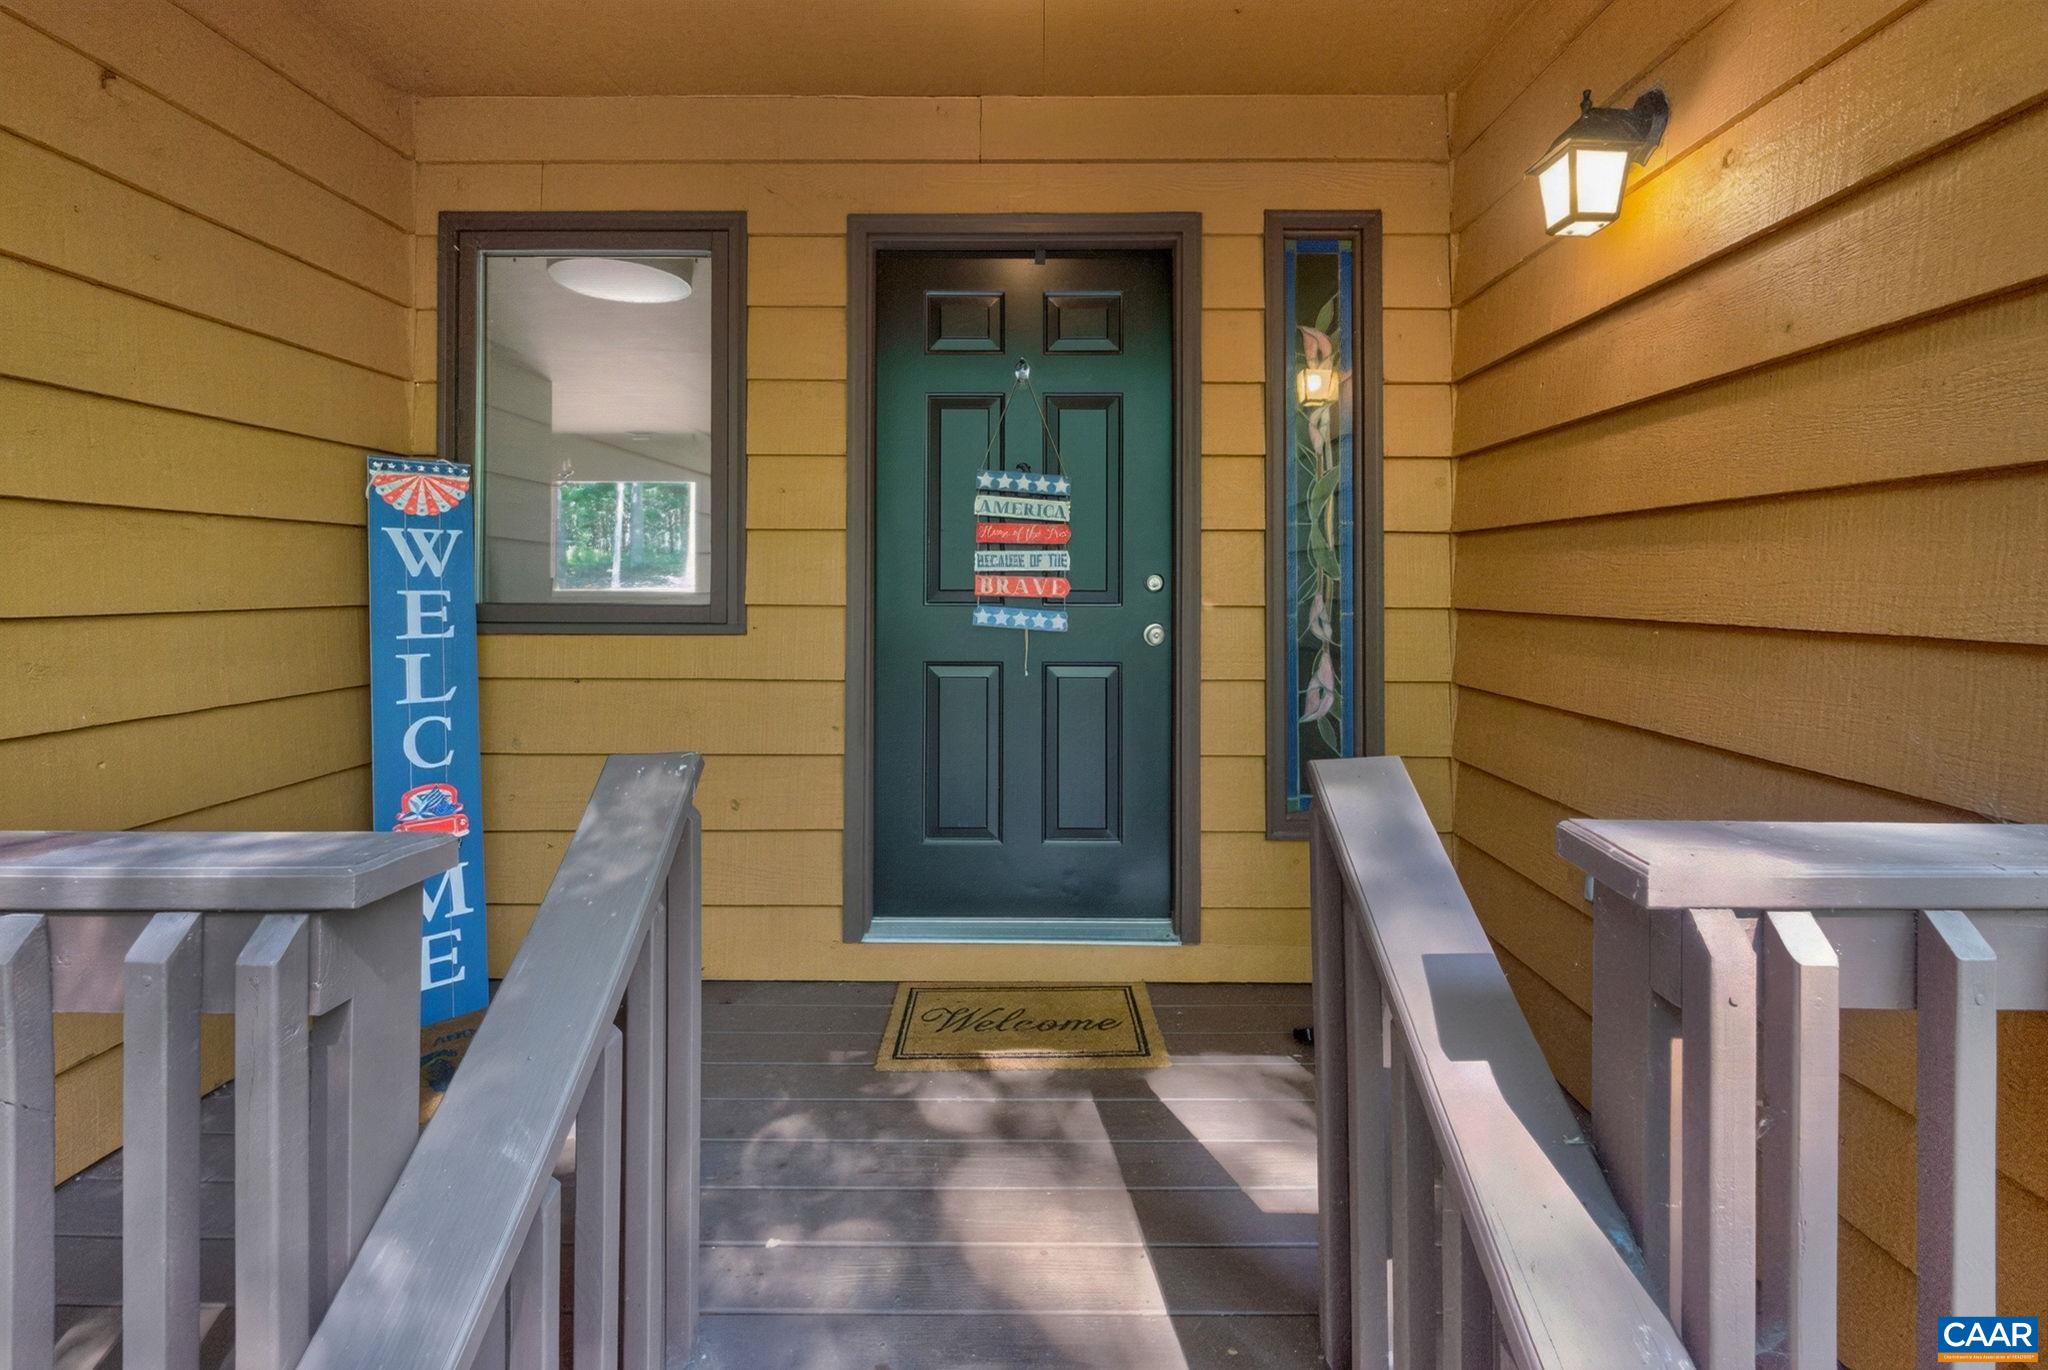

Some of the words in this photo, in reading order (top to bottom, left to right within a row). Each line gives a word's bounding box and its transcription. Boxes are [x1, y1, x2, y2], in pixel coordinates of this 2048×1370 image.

[980, 499, 1066, 519] AMERICA
[1012, 526, 1025, 543] of
[977, 553, 1025, 568] BECAUSE
[1030, 553, 1042, 568] OF
[1048, 553, 1068, 568] THE
[980, 576, 1066, 595] BRAVE
[921, 1007, 1125, 1034] Welcome
